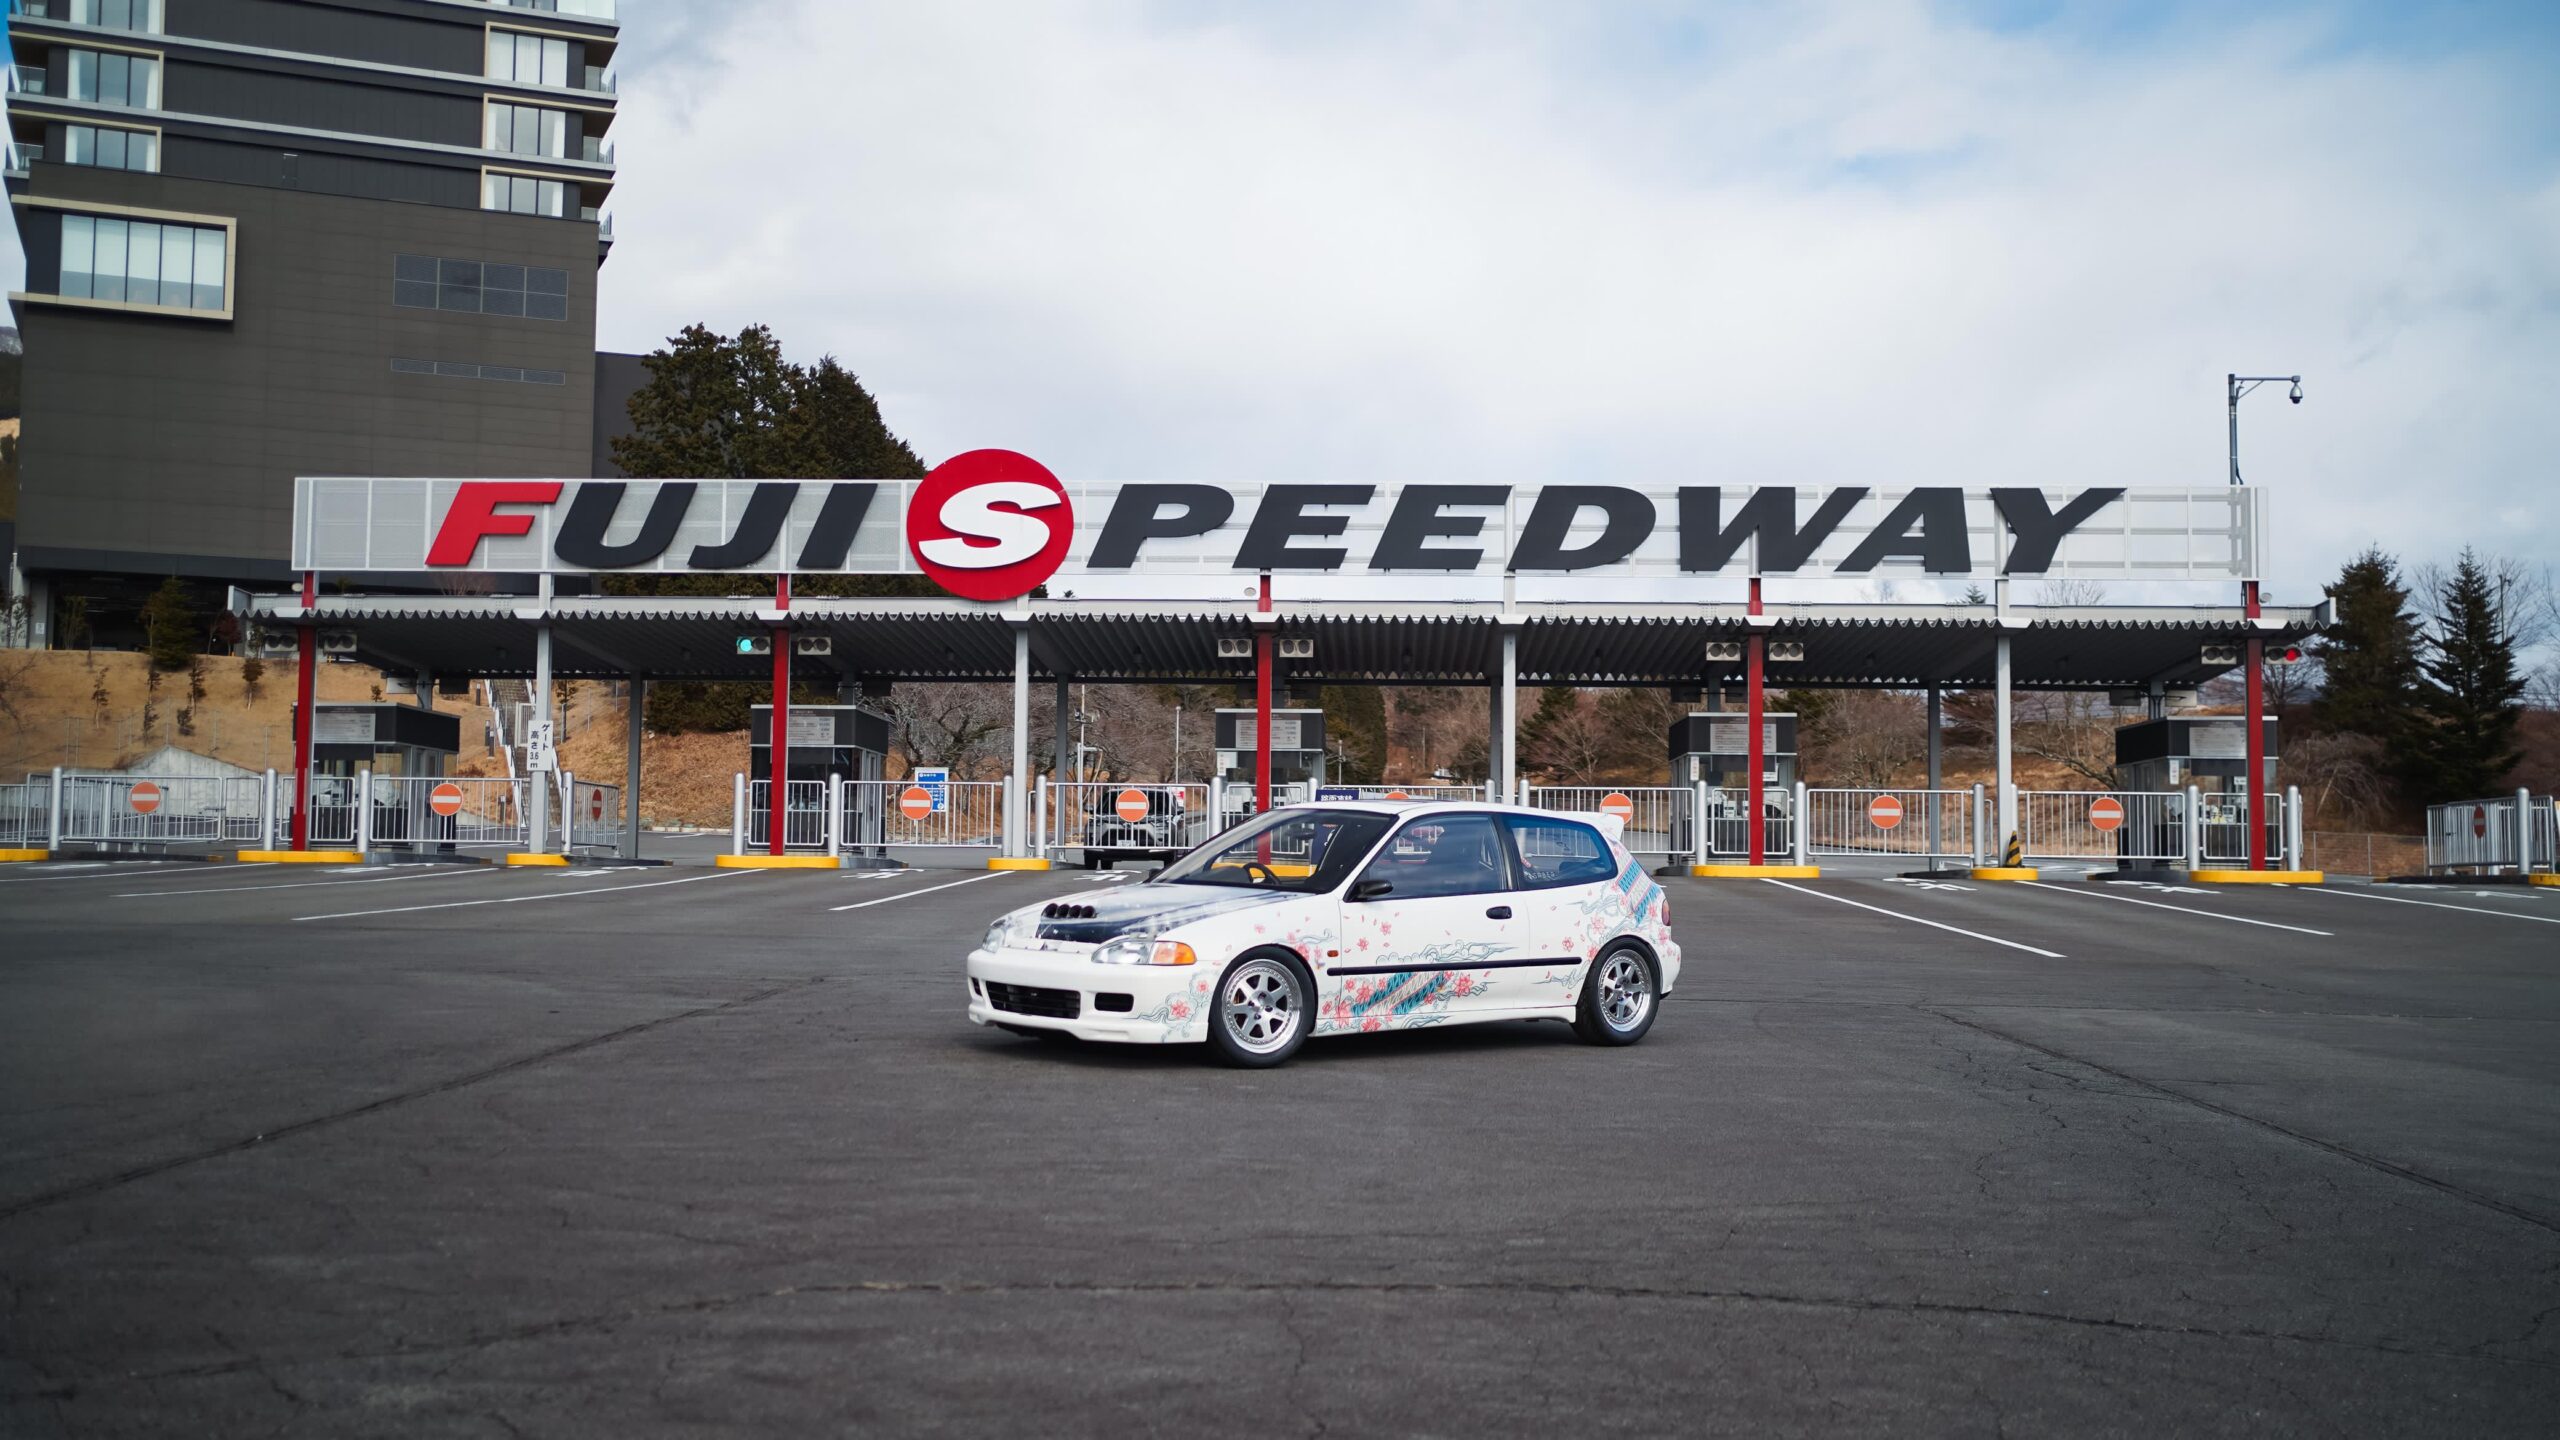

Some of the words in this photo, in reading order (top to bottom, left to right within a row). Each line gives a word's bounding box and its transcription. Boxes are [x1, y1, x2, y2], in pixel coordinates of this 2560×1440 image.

[426, 482, 878, 571] FUJI
[918, 481, 2126, 576] SPEEDWAY
[542, 724, 550, 751] ゲート
